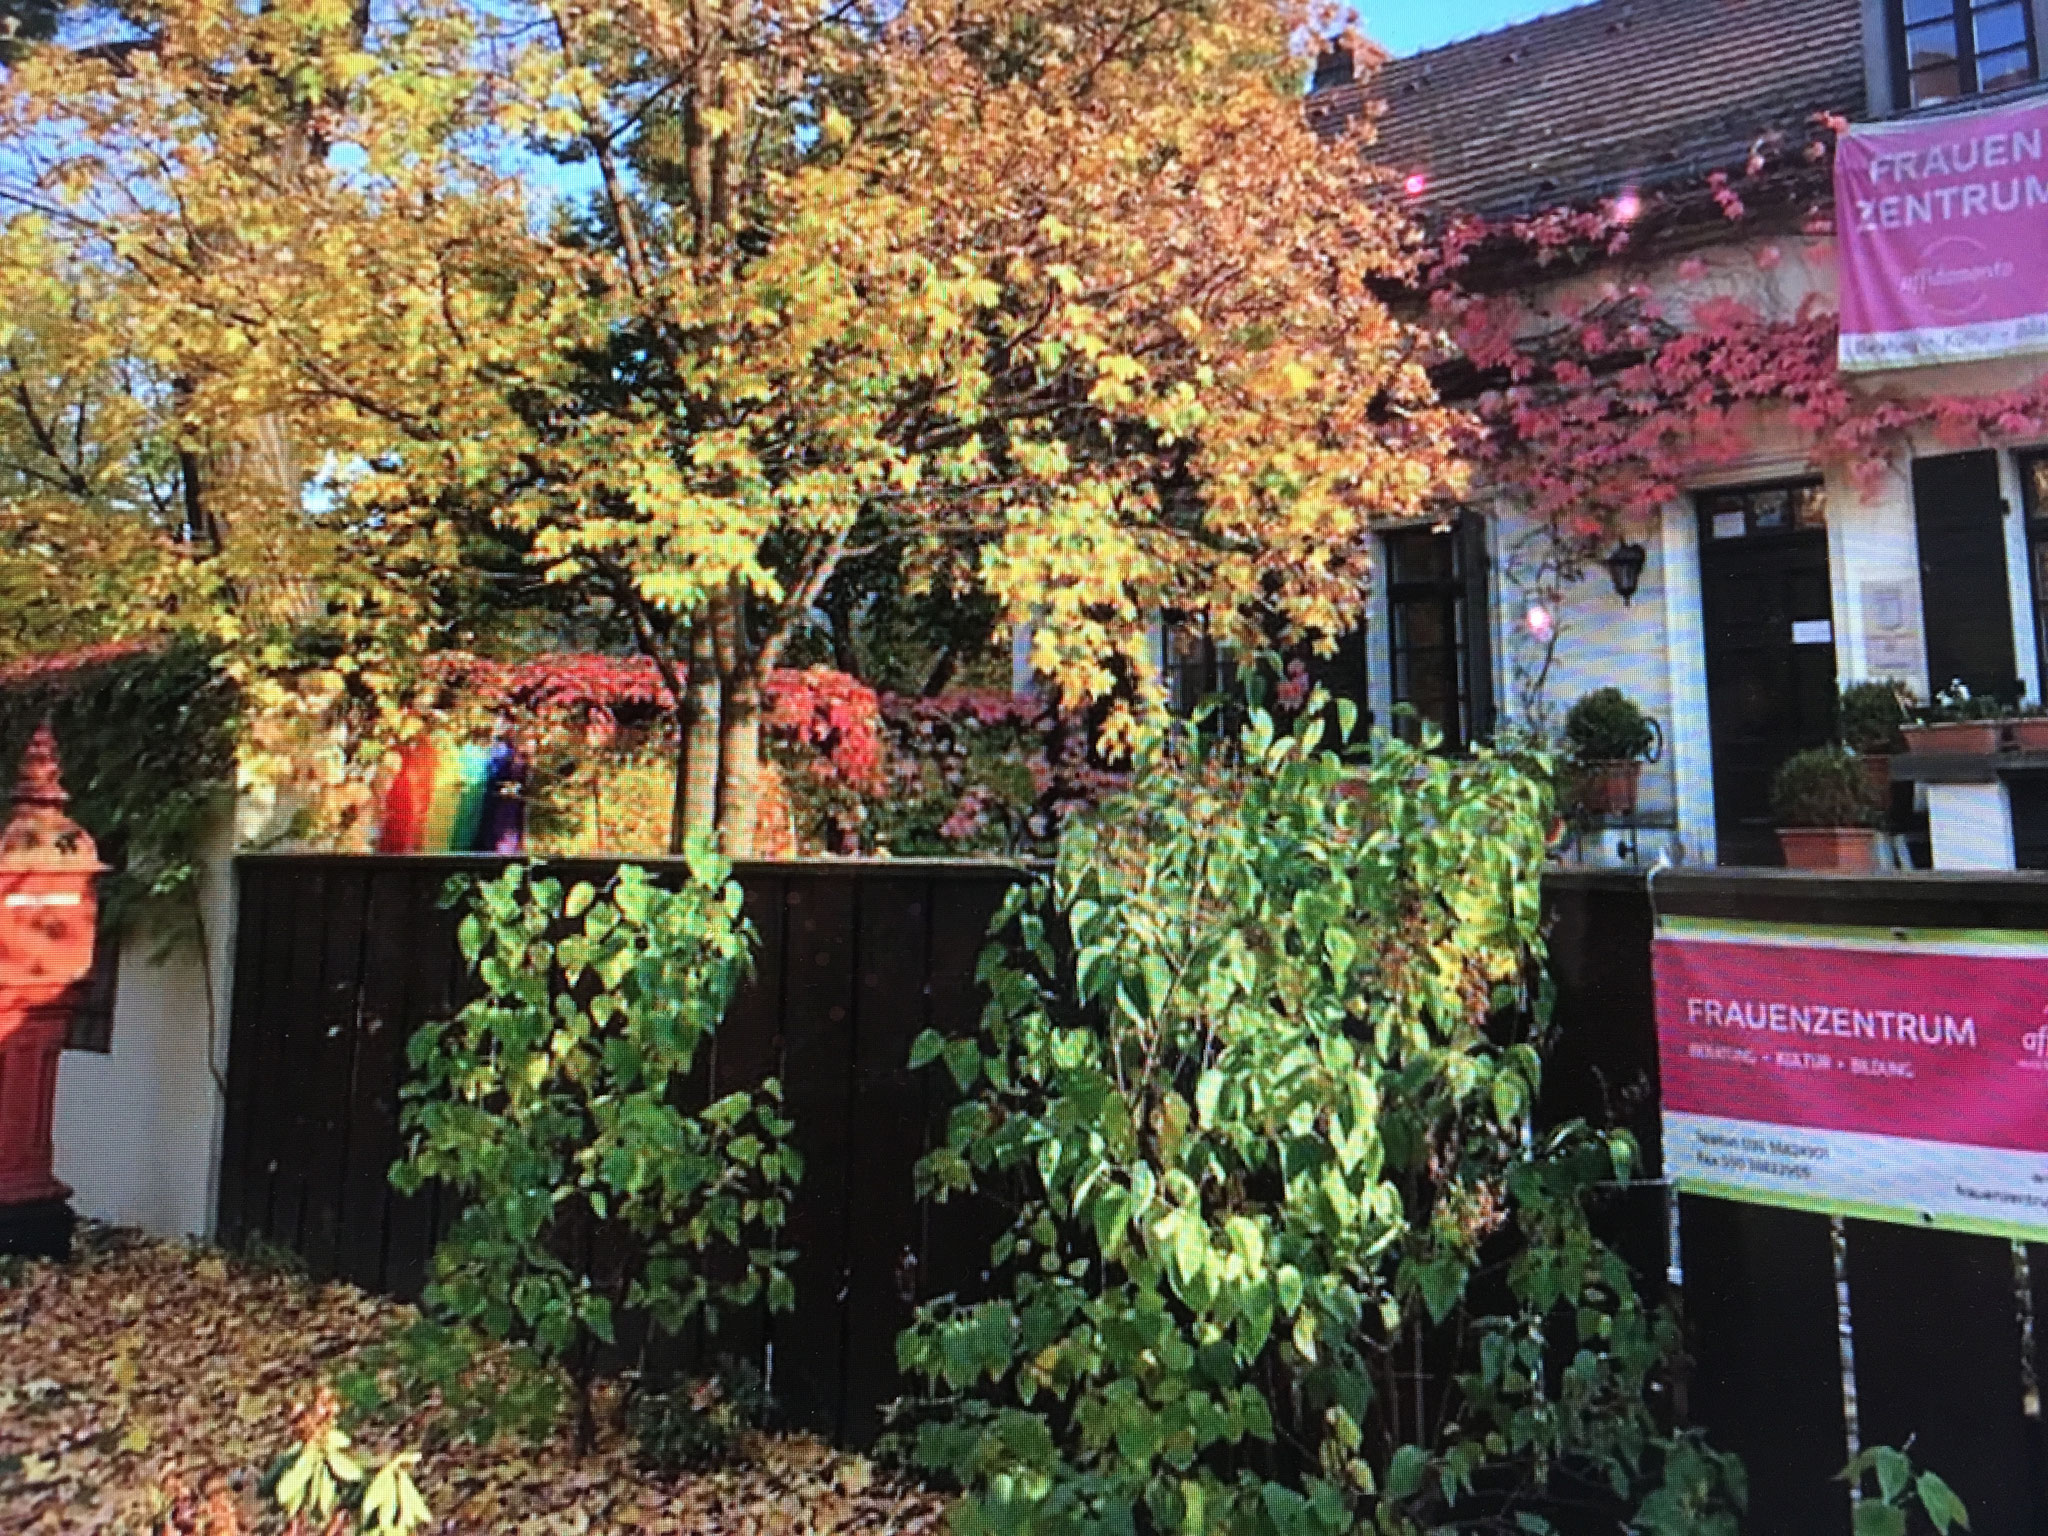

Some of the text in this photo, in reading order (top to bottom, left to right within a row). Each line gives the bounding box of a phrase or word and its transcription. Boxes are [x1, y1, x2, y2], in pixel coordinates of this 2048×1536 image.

[1869, 127, 2042, 185] FRAUEN
[1856, 174, 2048, 232] ZENTRUM
[1687, 997, 1977, 1048] FRAUENZENTRUM
